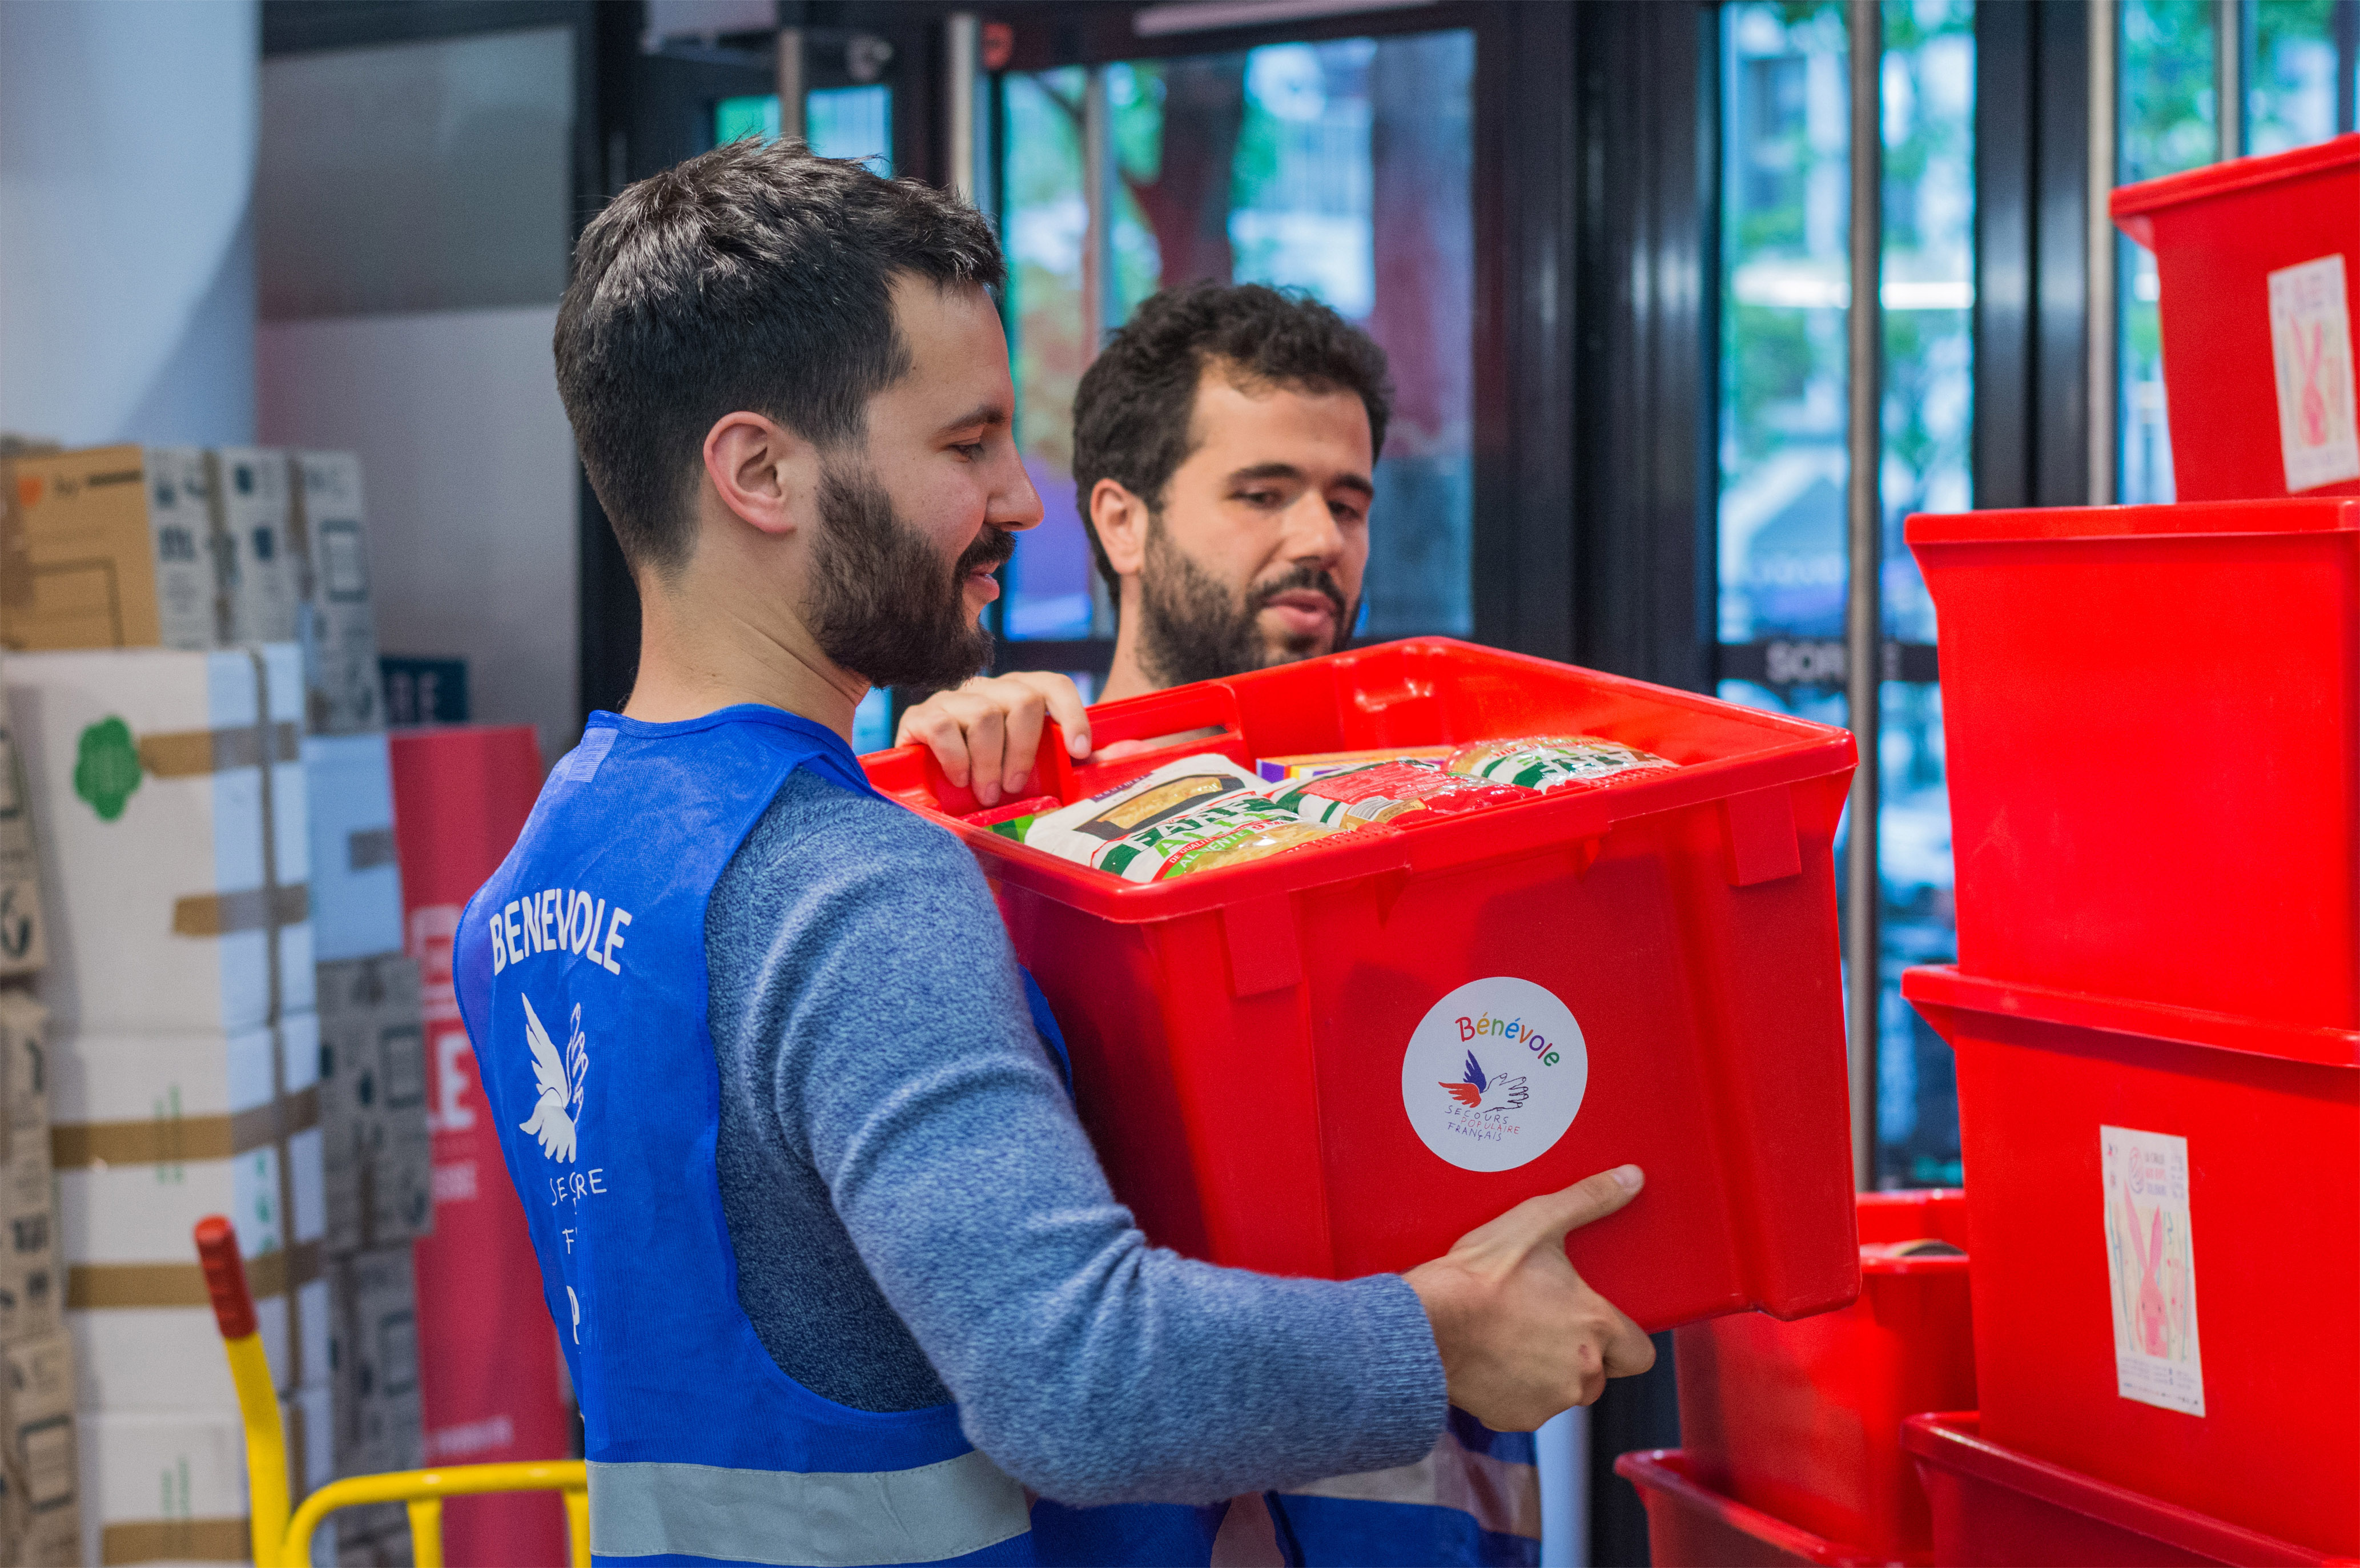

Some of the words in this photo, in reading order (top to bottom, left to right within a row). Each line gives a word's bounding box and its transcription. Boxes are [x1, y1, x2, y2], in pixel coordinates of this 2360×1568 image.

[1124, 798, 1252, 852] FARF
[1169, 854, 1181, 864] DE
[1179, 853, 1199, 868] AL
[489, 888, 633, 976] BENEVOLE
[1454, 1011, 1560, 1067] Bénévole
[1444, 1105, 1509, 1125] SECOURS
[1447, 1121, 1502, 1141] FRANÇAIS
[1460, 1116, 1521, 1135] POPULAIRE
